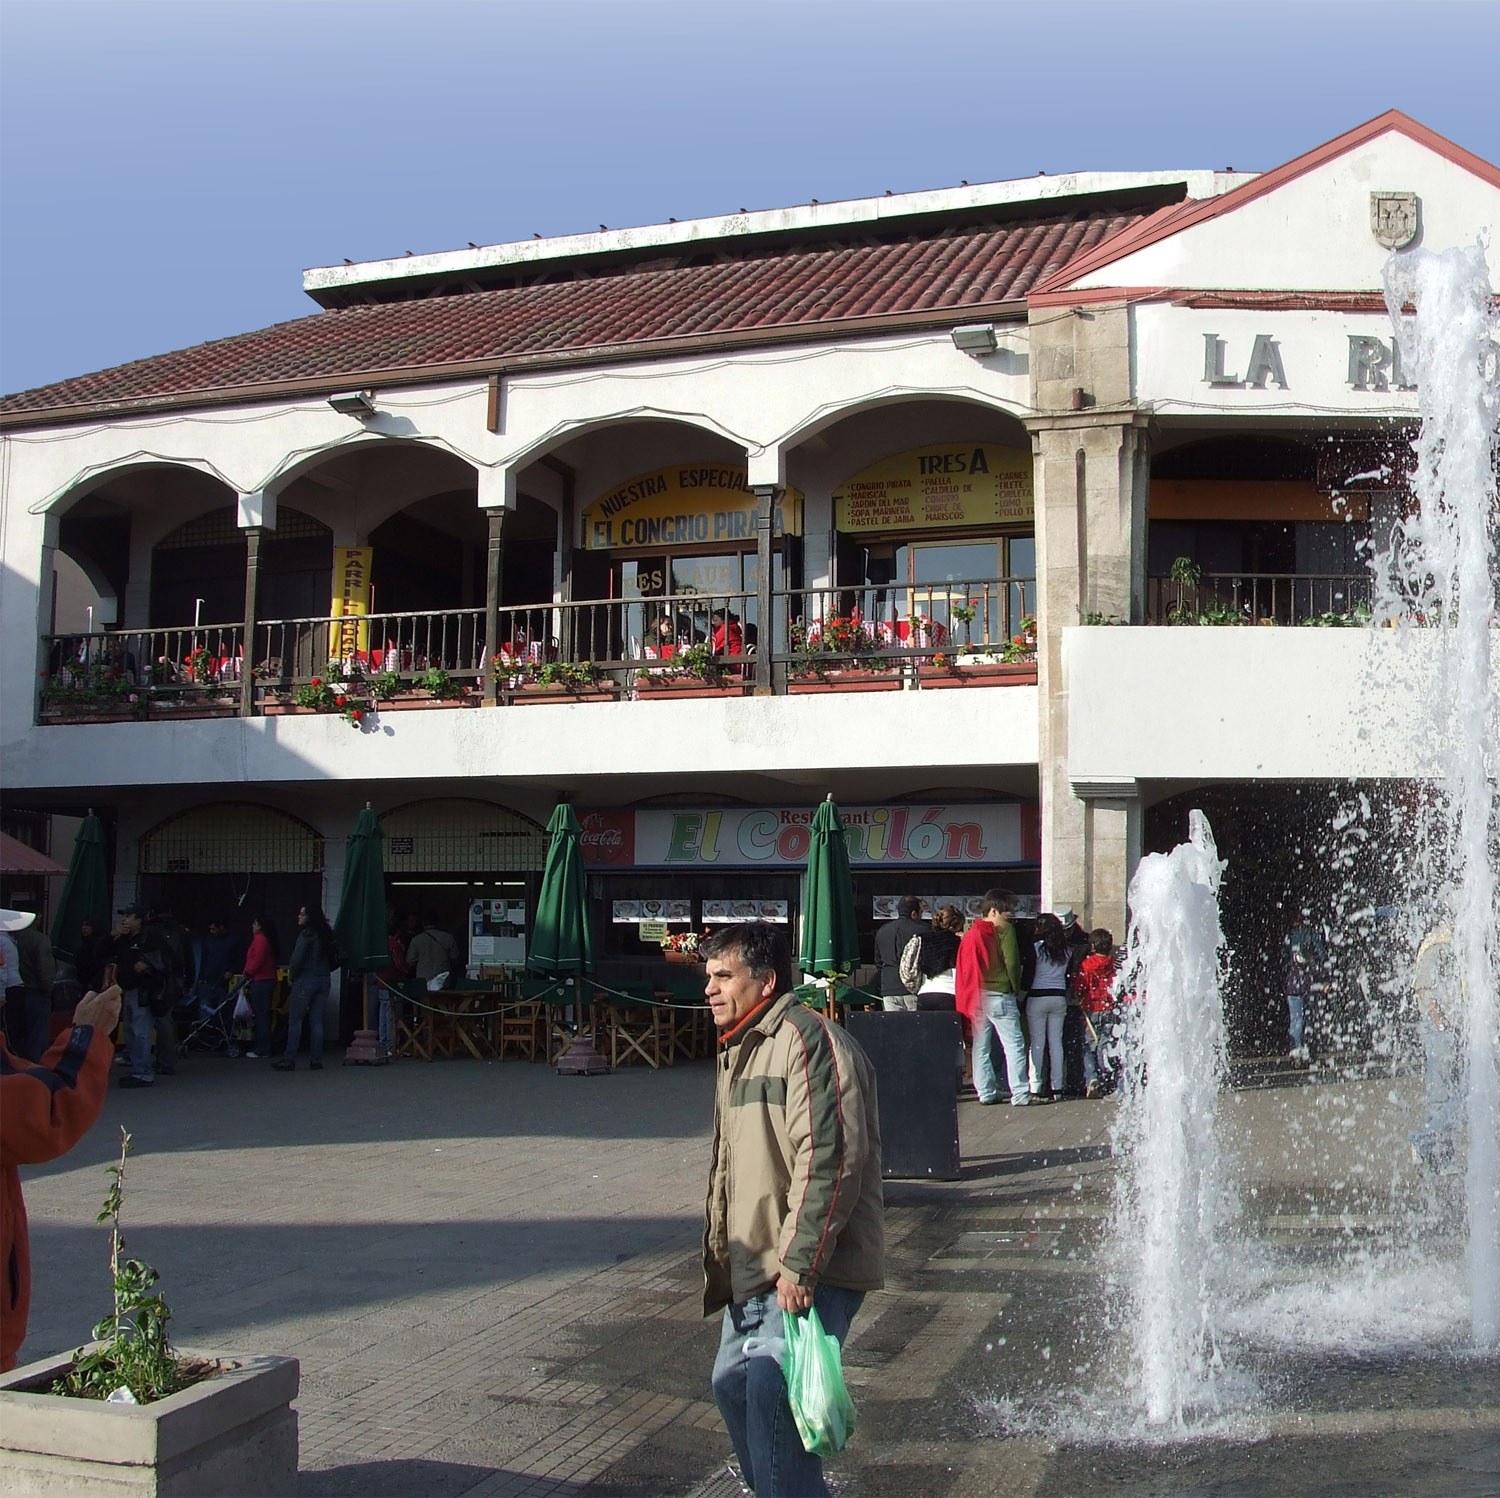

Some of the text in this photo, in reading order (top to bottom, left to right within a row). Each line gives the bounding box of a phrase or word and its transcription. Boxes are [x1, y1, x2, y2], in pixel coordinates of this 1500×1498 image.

[1202, 333, 1288, 387] LA
[917, 448, 989, 475] TRES A
[999, 471, 1028, 480] CARNES
[851, 480, 912, 491] CONGRIO PIRATA
[925, 477, 951, 486] PAELLA
[1000, 480, 1024, 489] FILETE
[851, 490, 888, 500] MARISCAL
[925, 484, 972, 495] CALDILLO DE
[600, 475, 667, 518] NUESTRA
[851, 499, 877, 509] JARDIN
[879, 498, 891, 507] DEL
[851, 507, 910, 518] SOPA MARINERA
[925, 511, 965, 521] MARISCOS
[1000, 507, 1023, 517] POLLO
[851, 517, 879, 527] PASTEL
[882, 516, 891, 525] DE
[593, 508, 785, 548] EL CONGRIO PIRAA
[664, 807, 987, 862] El Coilón
